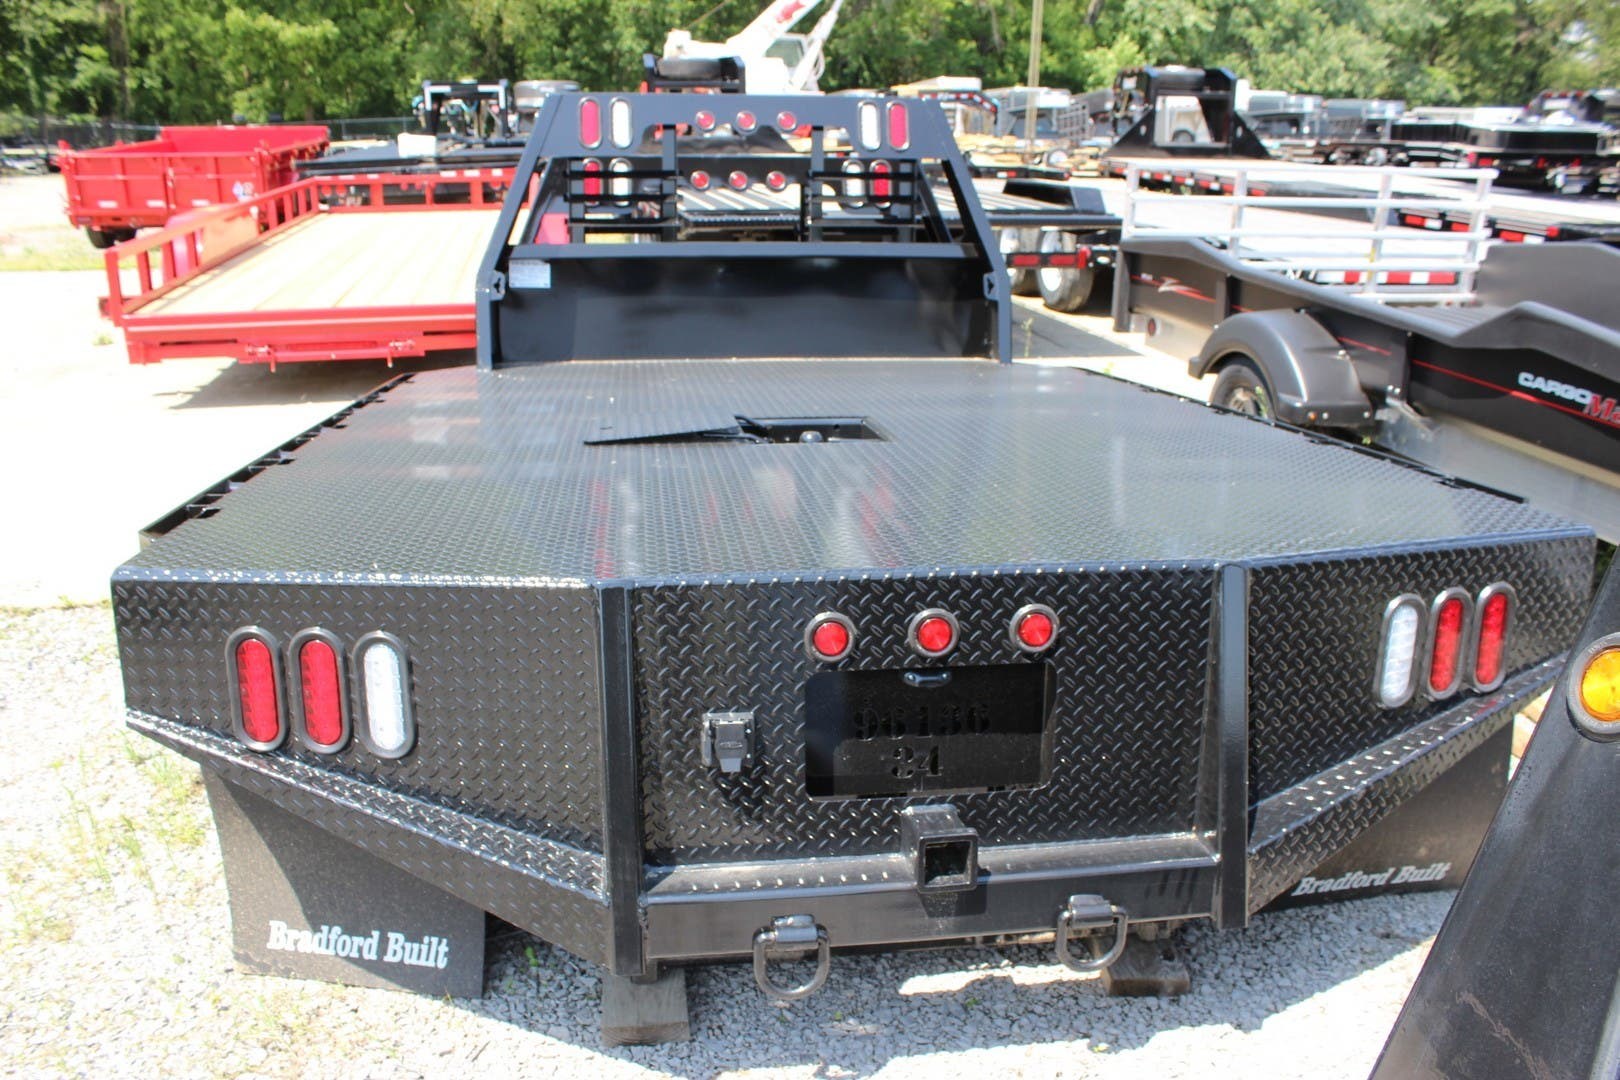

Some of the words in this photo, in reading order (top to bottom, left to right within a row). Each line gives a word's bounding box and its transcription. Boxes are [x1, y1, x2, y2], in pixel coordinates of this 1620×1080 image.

[1291, 867, 1396, 896] Bradford
[1390, 862, 1452, 884] Built
[266, 920, 380, 961] Bradford
[383, 931, 449, 969] Built
